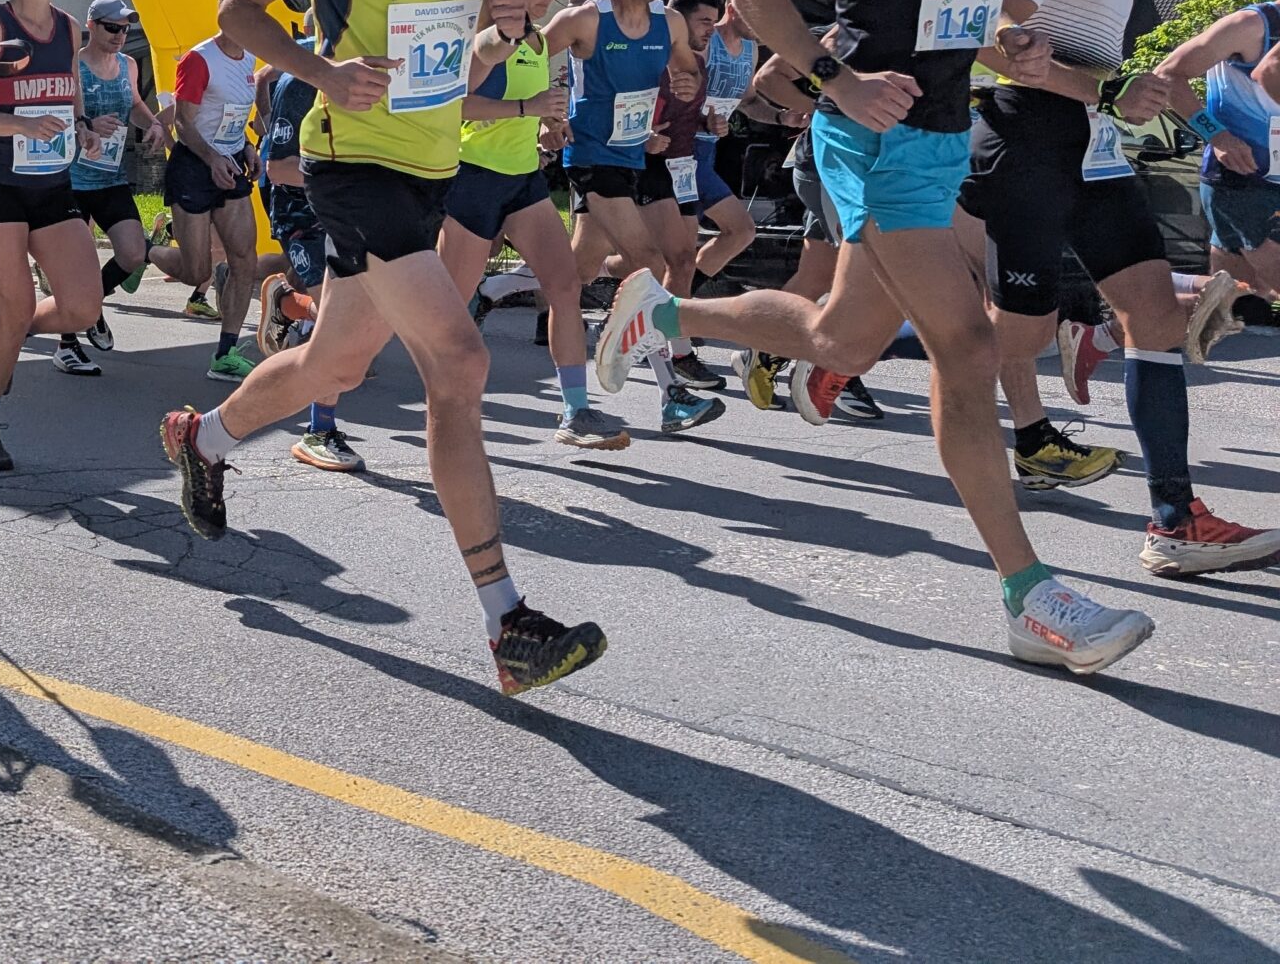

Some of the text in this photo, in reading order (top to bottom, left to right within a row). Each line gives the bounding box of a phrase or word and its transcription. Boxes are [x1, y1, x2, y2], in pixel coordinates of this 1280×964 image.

[415, 8, 438, 16] DAVID
[937, 5, 988, 39] 119
[412, 31, 425, 42] TEK
[426, 24, 436, 32] NA
[412, 38, 464, 77] 122
[228, 121, 243, 134] 13
